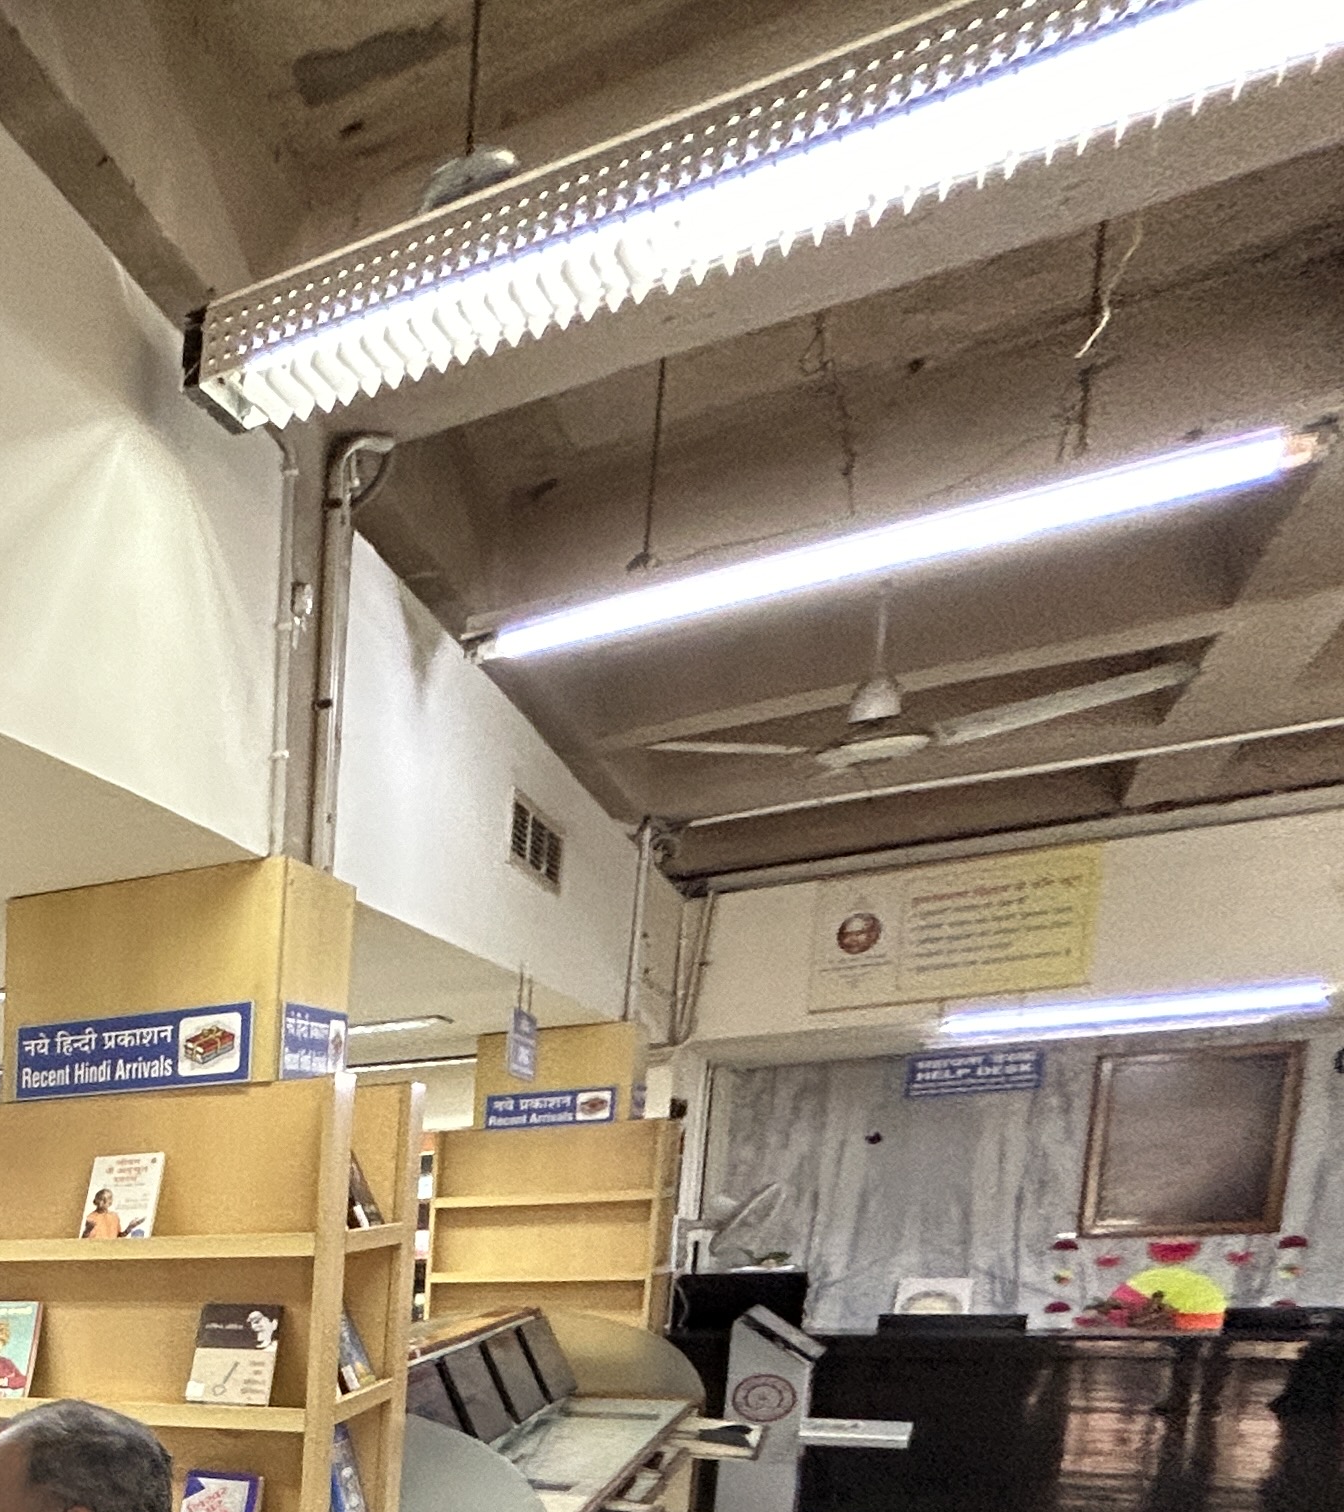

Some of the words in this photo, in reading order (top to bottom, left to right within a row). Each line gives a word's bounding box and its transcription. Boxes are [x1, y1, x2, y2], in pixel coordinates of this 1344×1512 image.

[22, 1034, 51, 1056] नये
[55, 1027, 97, 1054] हिन्दी
[102, 1025, 174, 1050] प्रकाशन
[22, 1065, 70, 1089] Recent
[74, 1060, 111, 1083] Hindi
[114, 1055, 173, 1081] Arrivals
